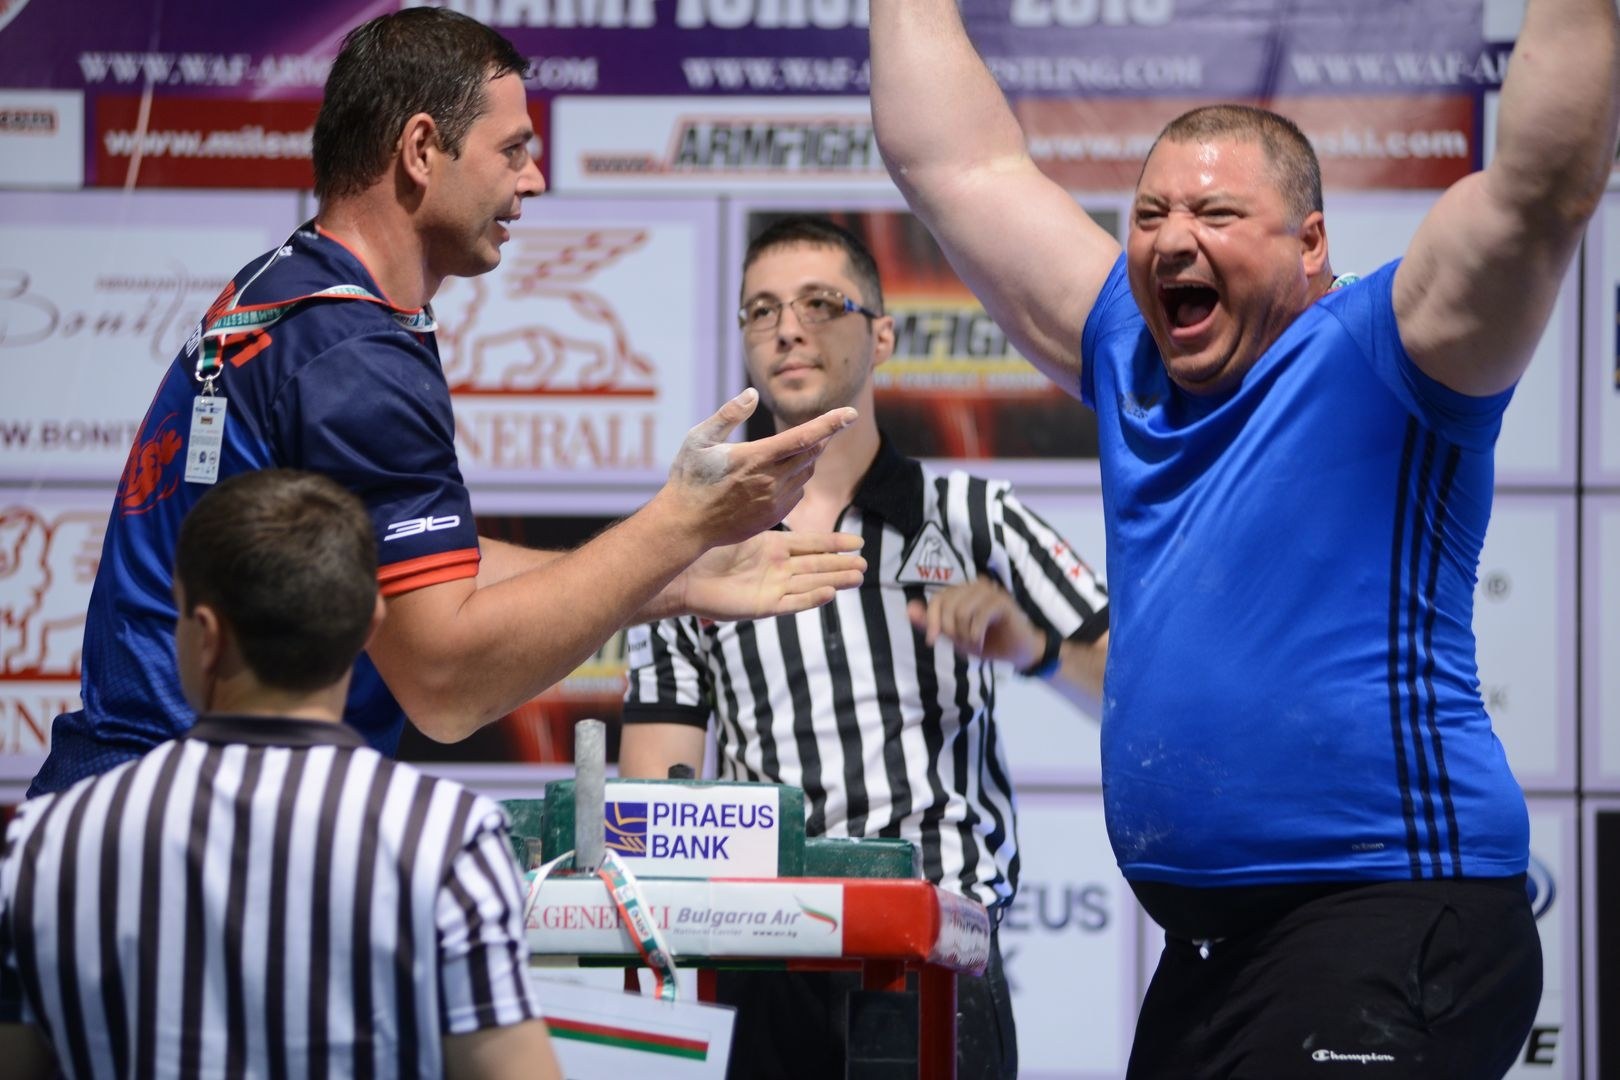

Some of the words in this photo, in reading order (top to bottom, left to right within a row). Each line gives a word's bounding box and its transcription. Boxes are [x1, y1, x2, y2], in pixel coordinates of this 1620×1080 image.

[916, 564, 954, 582] WAF
[652, 802, 775, 829] PIRAEUS
[651, 834, 731, 860] BANK
[676, 906, 768, 928] Bulgaria
[770, 909, 801, 925] Air
[1311, 1049, 1395, 1064] Champion
